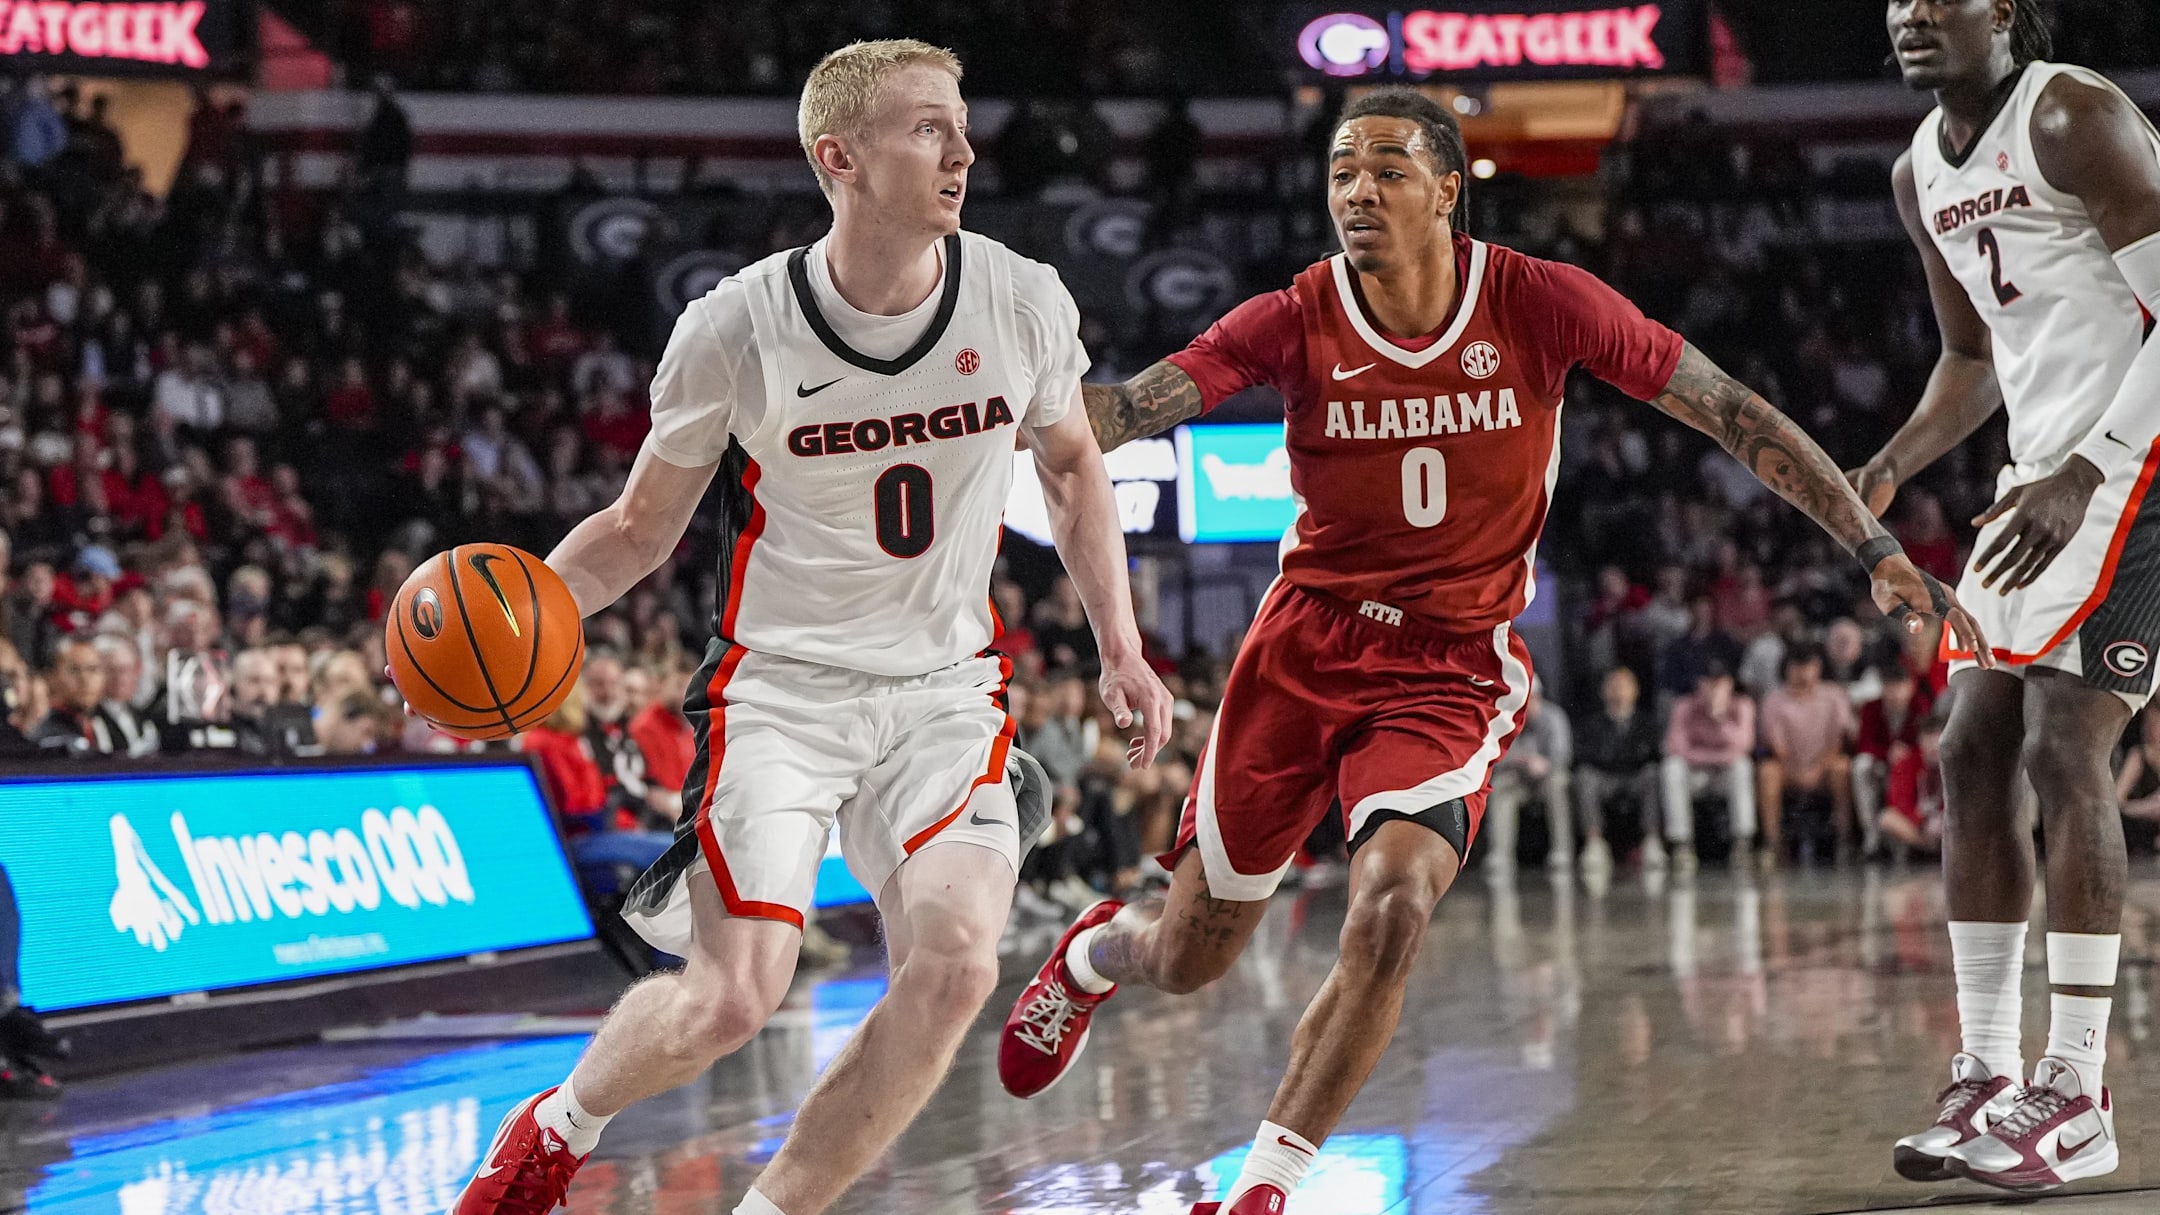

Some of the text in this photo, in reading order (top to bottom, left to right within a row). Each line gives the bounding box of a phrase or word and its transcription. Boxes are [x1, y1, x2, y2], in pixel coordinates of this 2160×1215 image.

[0, 0, 210, 69] ATGEEK
[1403, 4, 1664, 70] SEATGEEK
[1978, 227, 2023, 307] 2
[957, 350, 978, 374] SEC
[1464, 343, 1497, 377] SEC
[788, 395, 1014, 457] GEORGIA
[1325, 388, 1522, 439] ALABAMA
[874, 463, 934, 559] 0
[1401, 447, 1446, 528] 0
[1358, 600, 1403, 627] RTR
[171, 810, 380, 925] Invesco
